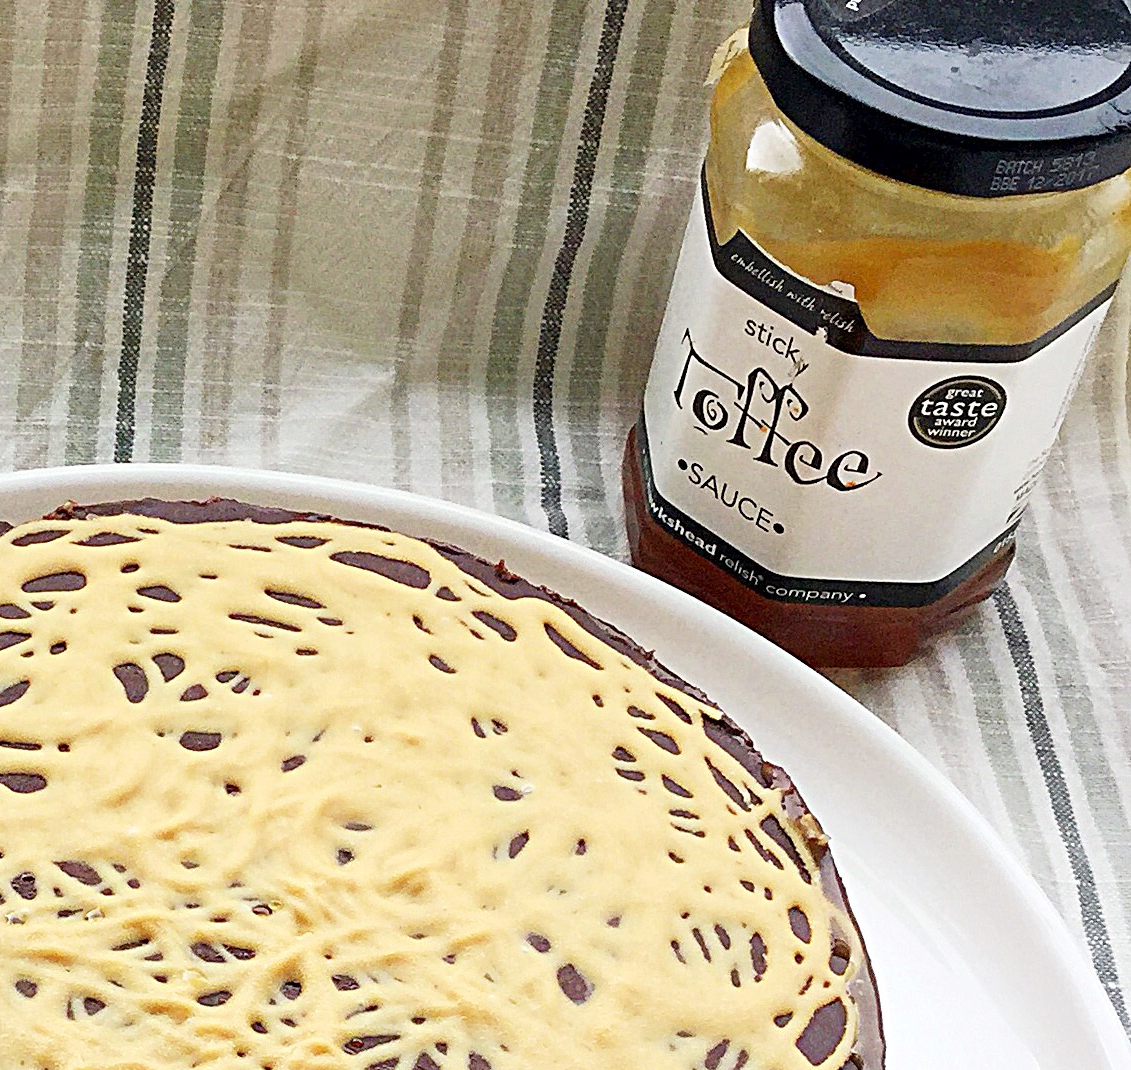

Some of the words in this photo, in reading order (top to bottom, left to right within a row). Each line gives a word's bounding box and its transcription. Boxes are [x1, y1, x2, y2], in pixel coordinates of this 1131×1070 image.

[995, 159, 1045, 175] BATCH
[990, 176, 1021, 191] BBE
[730, 253, 785, 293] embellish
[786, 291, 817, 311] with
[820, 308, 856, 333] relish
[945, 388, 984, 400] great
[673, 327, 883, 492] Toffee
[921, 399, 998, 417] taste
[934, 416, 978, 428] award
[928, 427, 976, 438] winner
[765, 584, 853, 604] company
